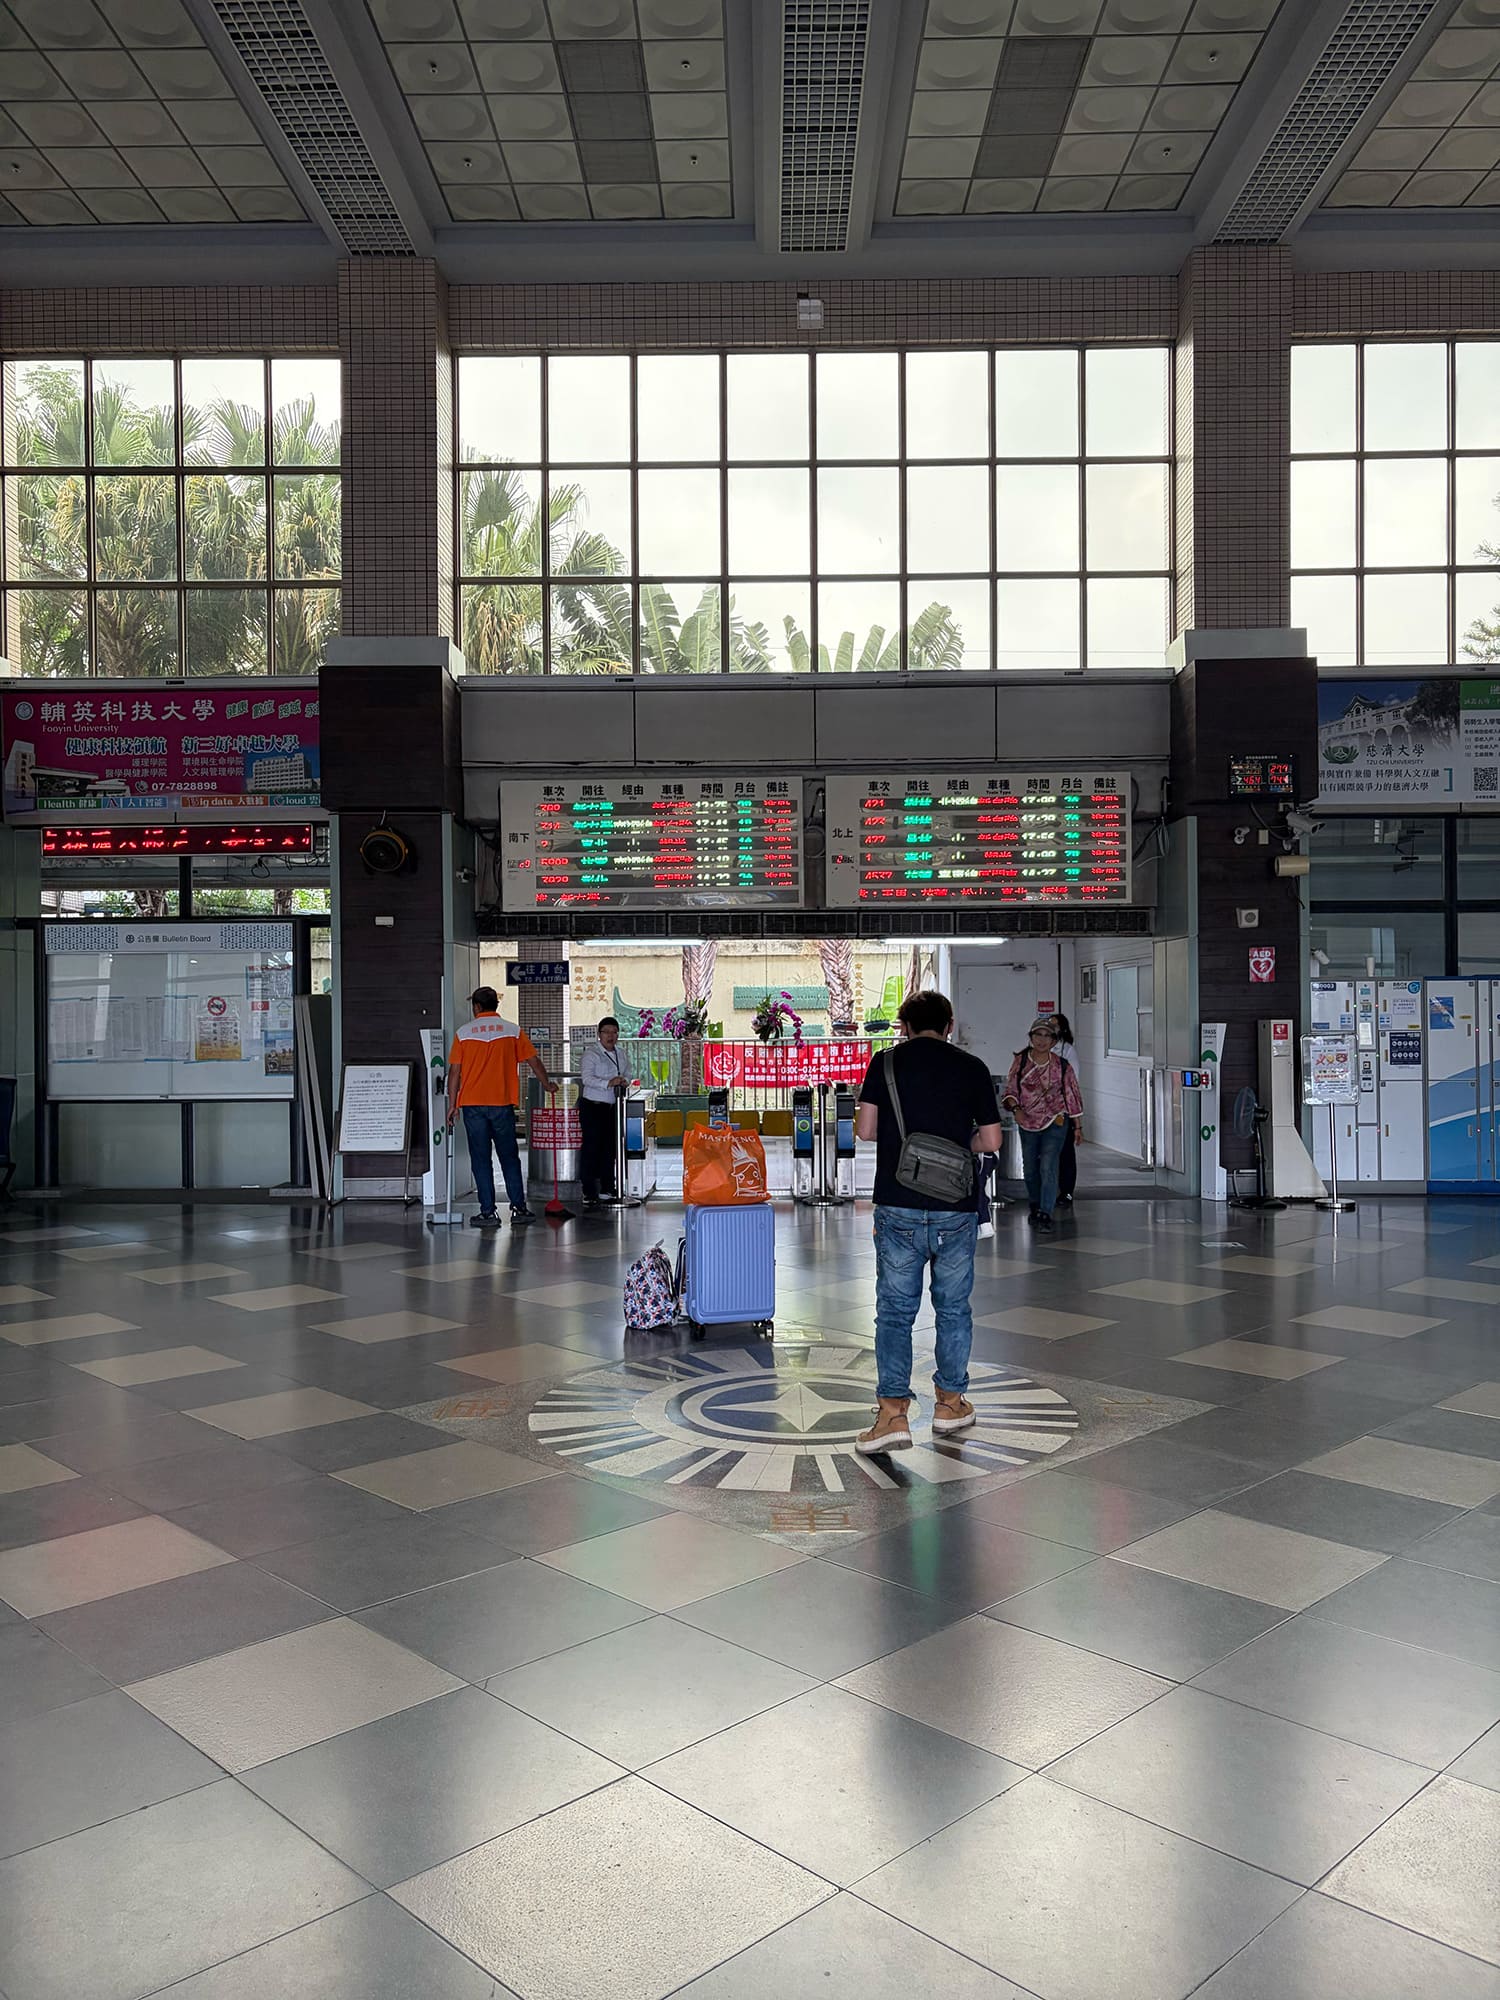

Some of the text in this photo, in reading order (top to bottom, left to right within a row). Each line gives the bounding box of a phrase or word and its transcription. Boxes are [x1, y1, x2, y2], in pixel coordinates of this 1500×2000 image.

[40, 699, 216, 722] 輔英科技大學
[42, 723, 120, 735] Fooyin University
[65, 734, 300, 756] 健康科技領航 新三好卓越大學
[1366, 743, 1425, 758] 慈濟大學
[151, 782, 218, 791] 07-7828898
[543, 781, 789, 797] 車次 開往 經由 車種 時間 月台 備註
[868, 777, 1117, 791] 車次 開往 經由 車種 時間 月台 備註
[508, 832, 530, 843] 南下
[832, 828, 853, 838] 北上
[162, 935, 211, 943] Bulletin Board
[1252, 950, 1271, 958] AED
[525, 963, 565, 975] 往月台
